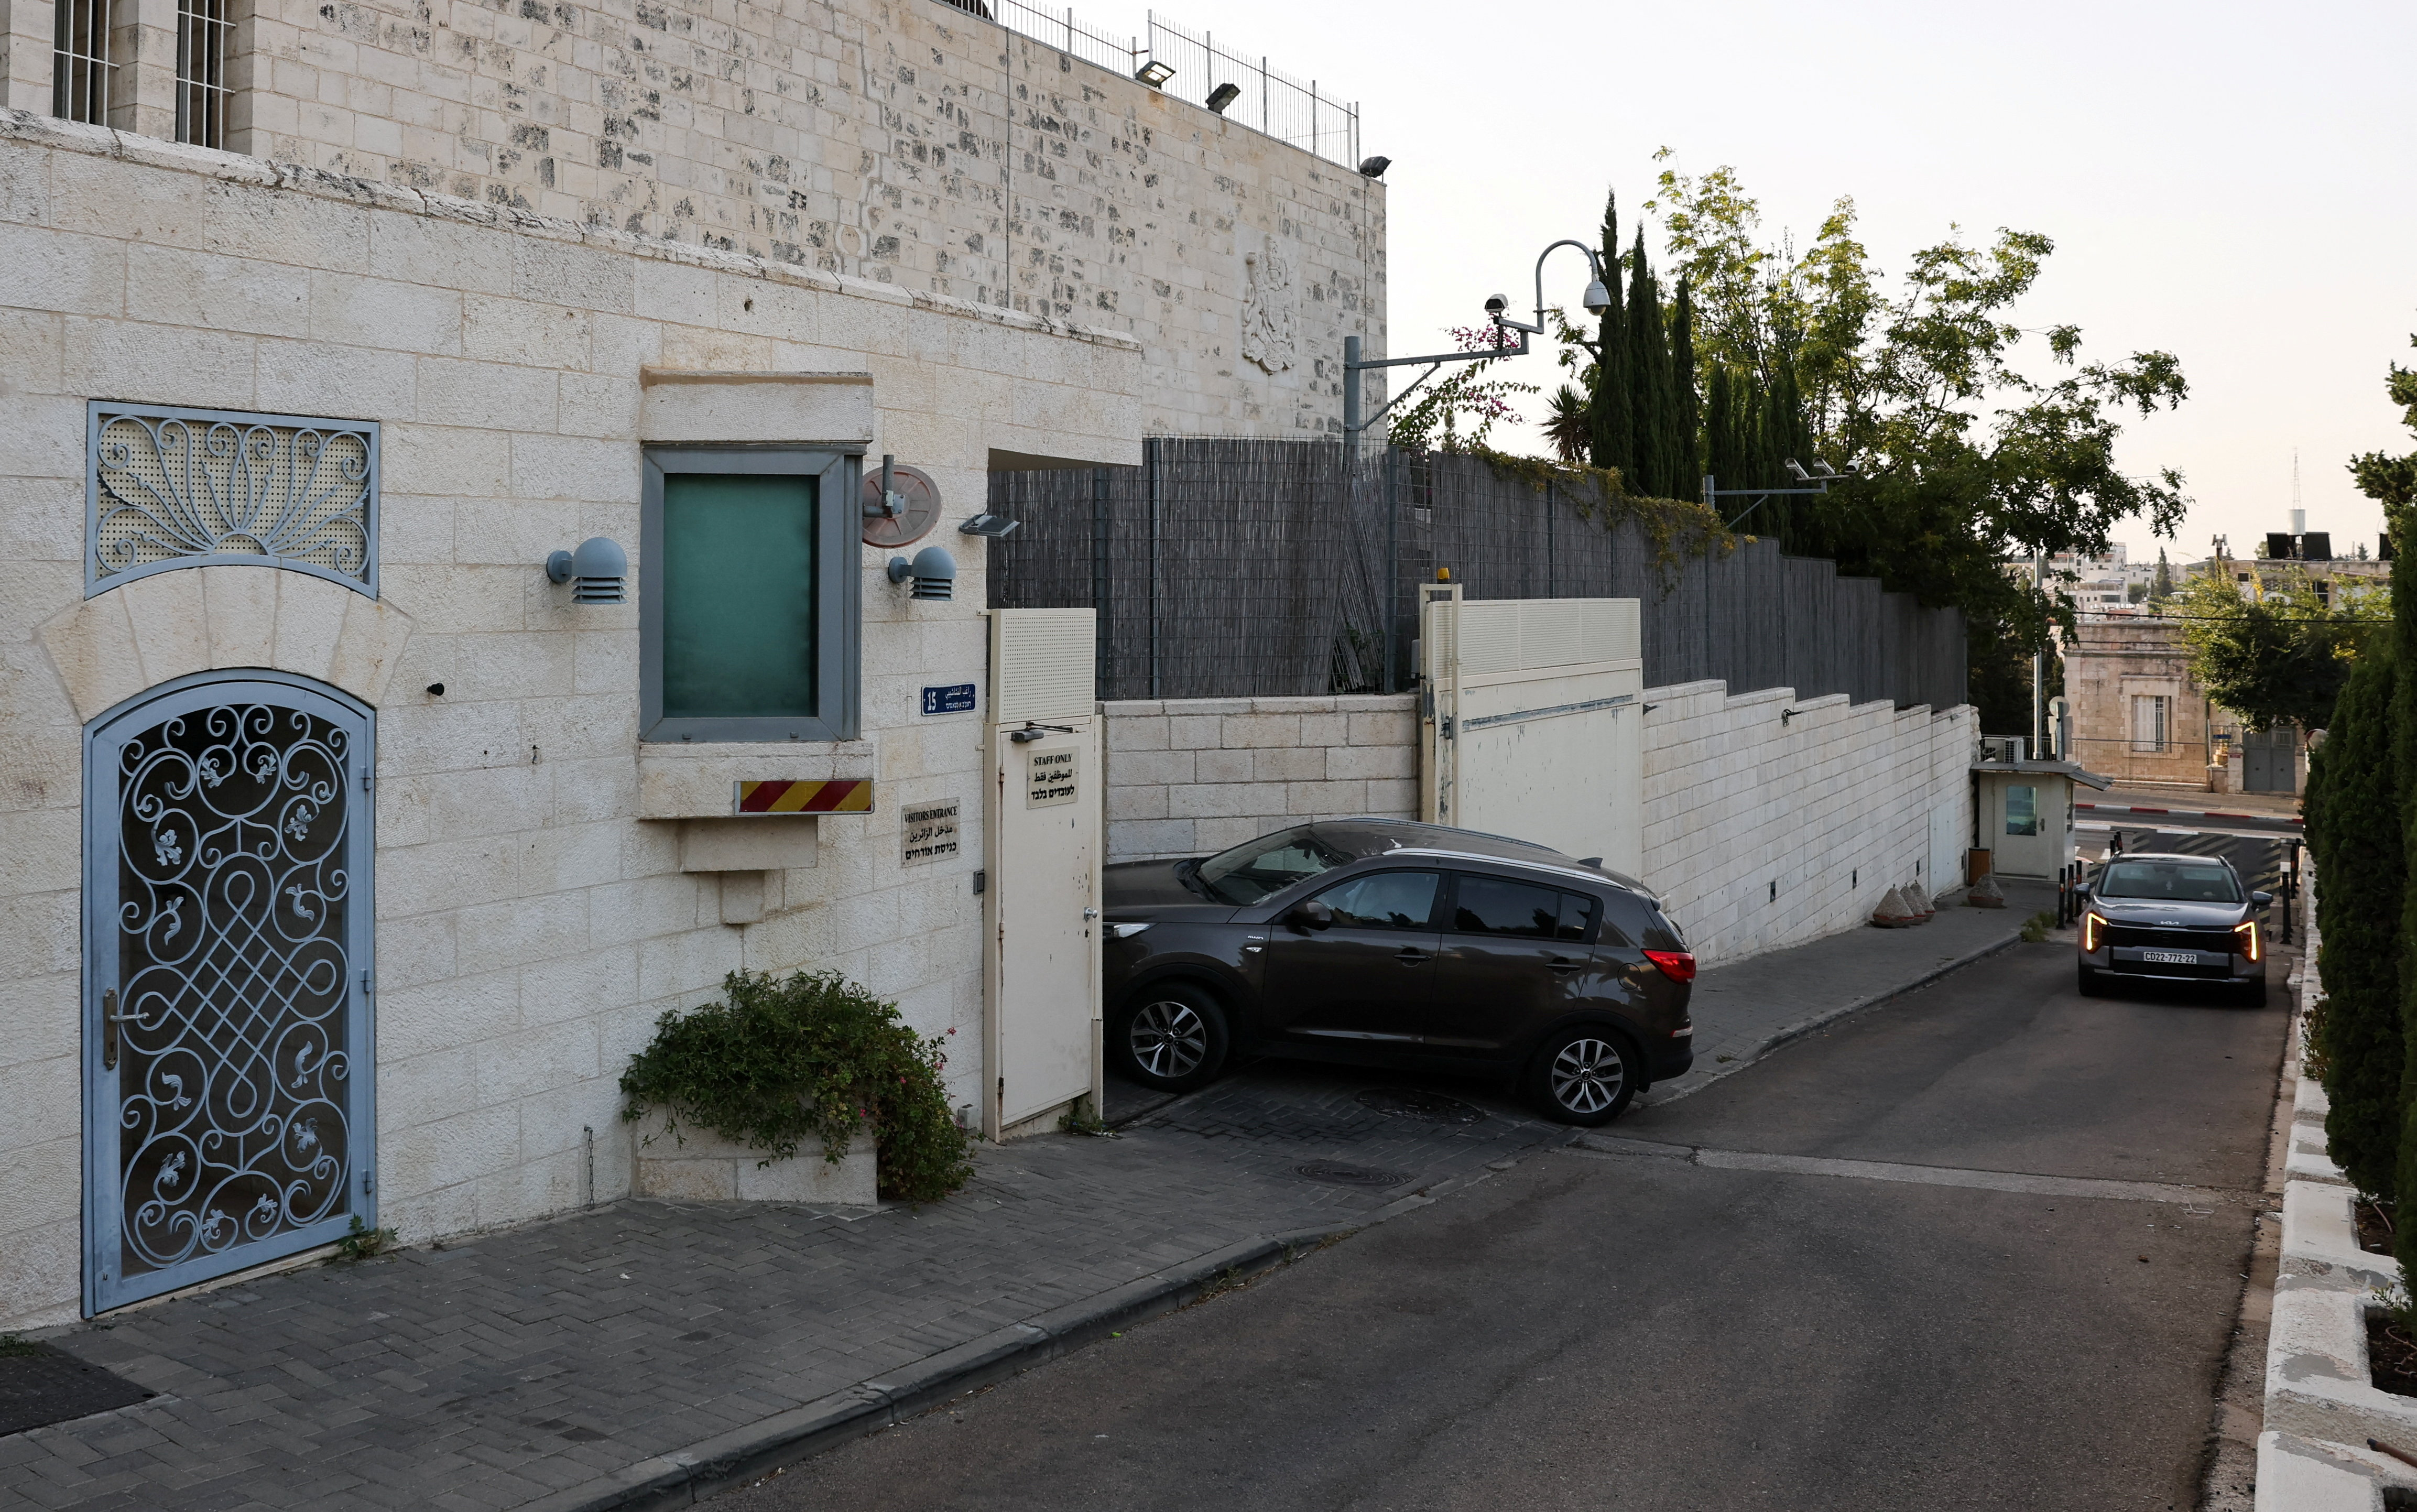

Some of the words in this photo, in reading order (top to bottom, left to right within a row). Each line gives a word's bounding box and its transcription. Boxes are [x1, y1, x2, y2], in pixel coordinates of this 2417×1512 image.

[928, 691, 936, 711] 15
[1034, 755, 1054, 766] STAFF
[1055, 753, 1073, 764] ONLY
[1034, 771, 1047, 782] فقط
[1048, 769, 1072, 783] للموظفين
[1031, 788, 1047, 800] בלבד
[1049, 784, 1075, 798] לעובדים
[905, 811, 929, 823] VISITORS
[930, 806, 957, 819] ENTRANCE
[910, 827, 932, 843] الزائرين
[905, 846, 933, 860] אורחים
[934, 842, 956, 855] כניסת
[2145, 952, 2195, 963] CD22-772-22
